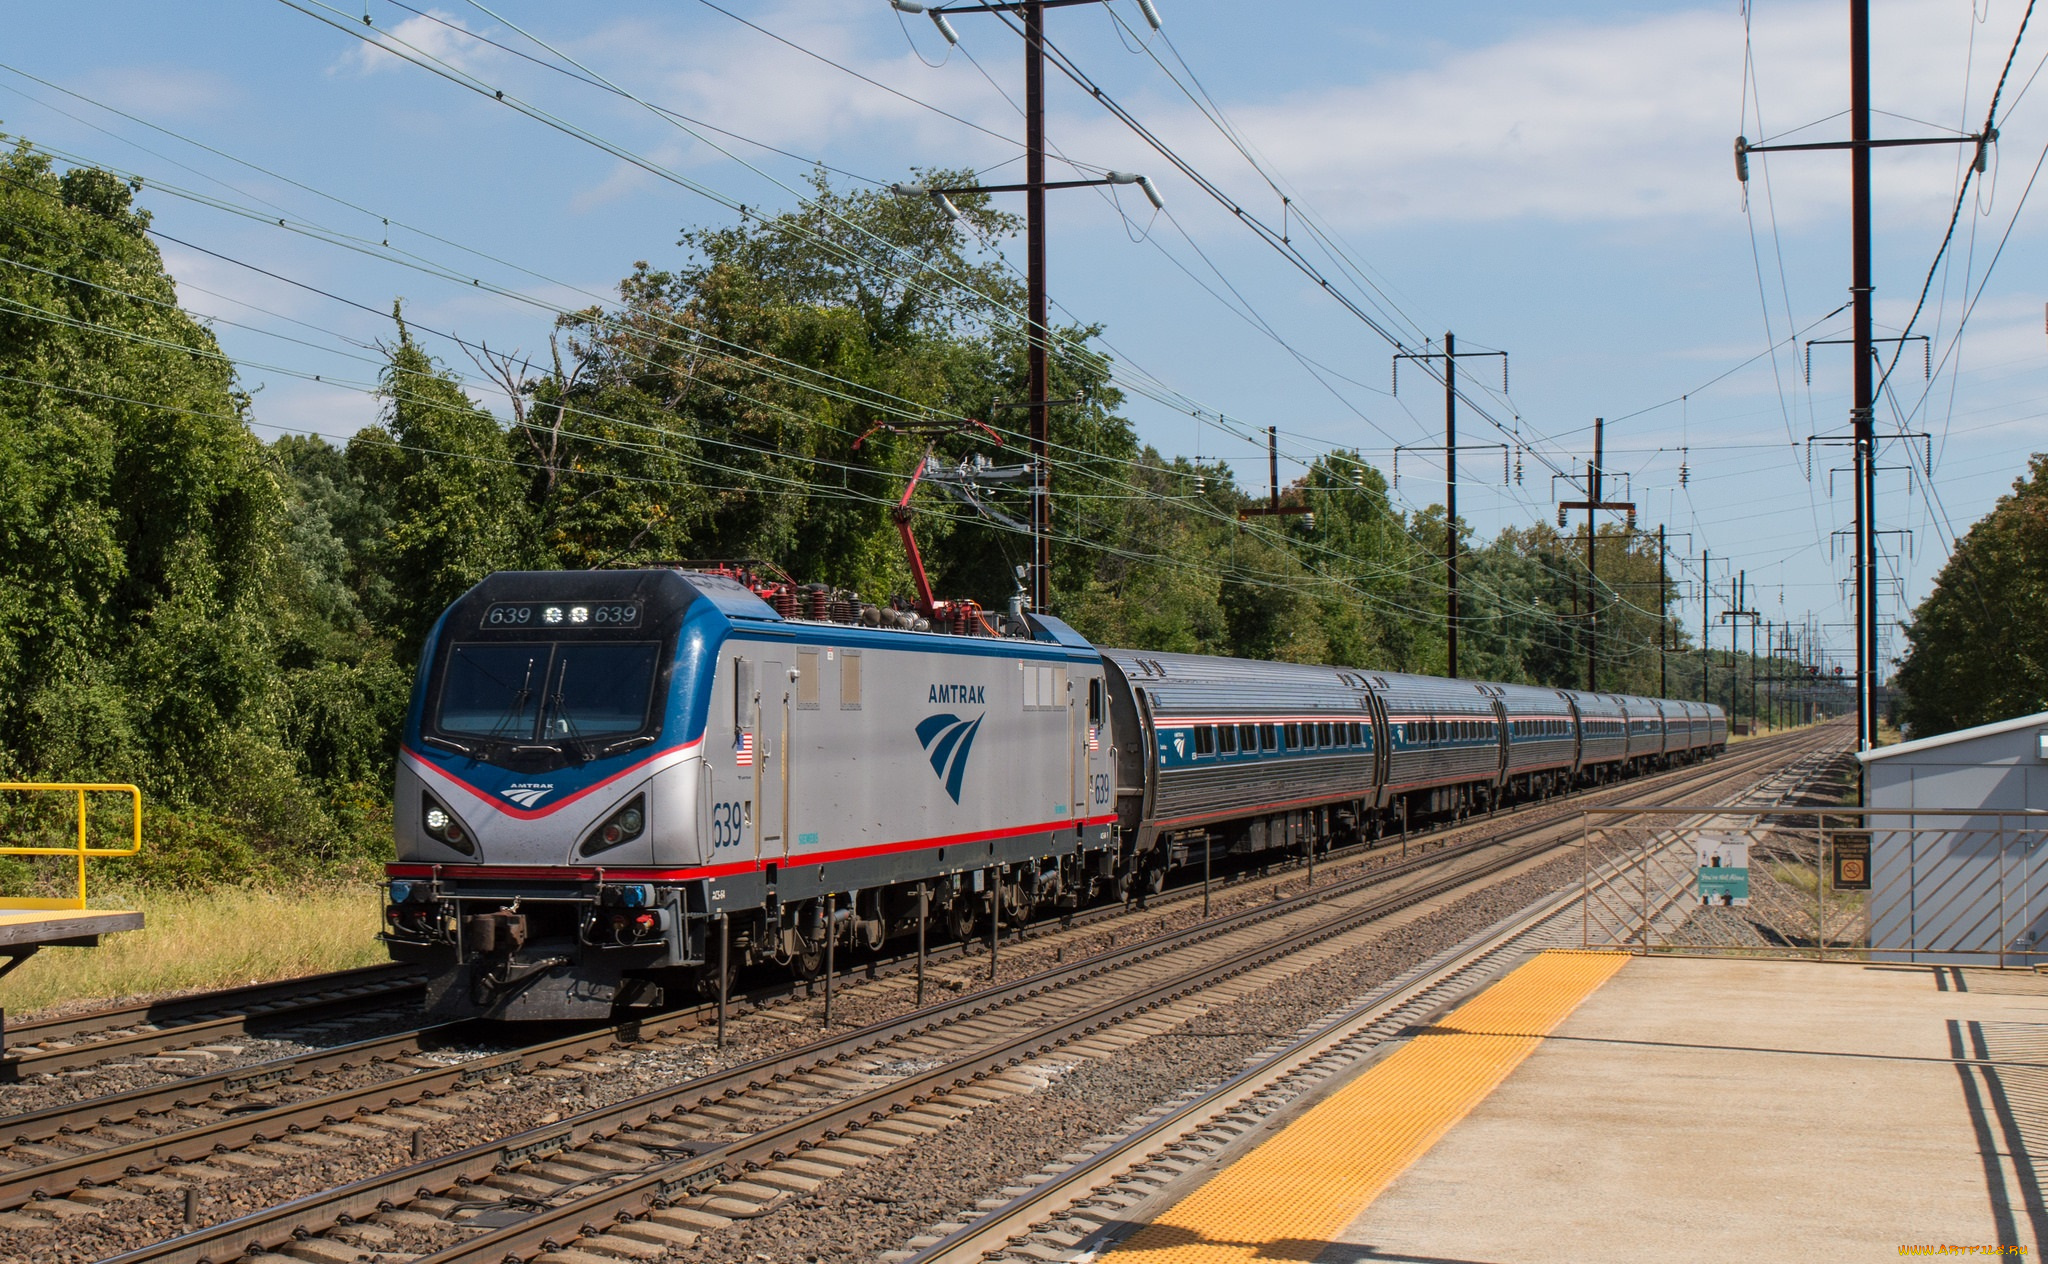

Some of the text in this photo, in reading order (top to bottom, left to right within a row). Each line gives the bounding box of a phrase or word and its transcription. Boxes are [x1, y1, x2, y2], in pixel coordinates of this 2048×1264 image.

[490, 607, 531, 624] 639
[595, 606, 636, 623] 639
[928, 684, 985, 704] AMTRAK
[1095, 773, 1110, 804] 639
[713, 801, 742, 848] 639
